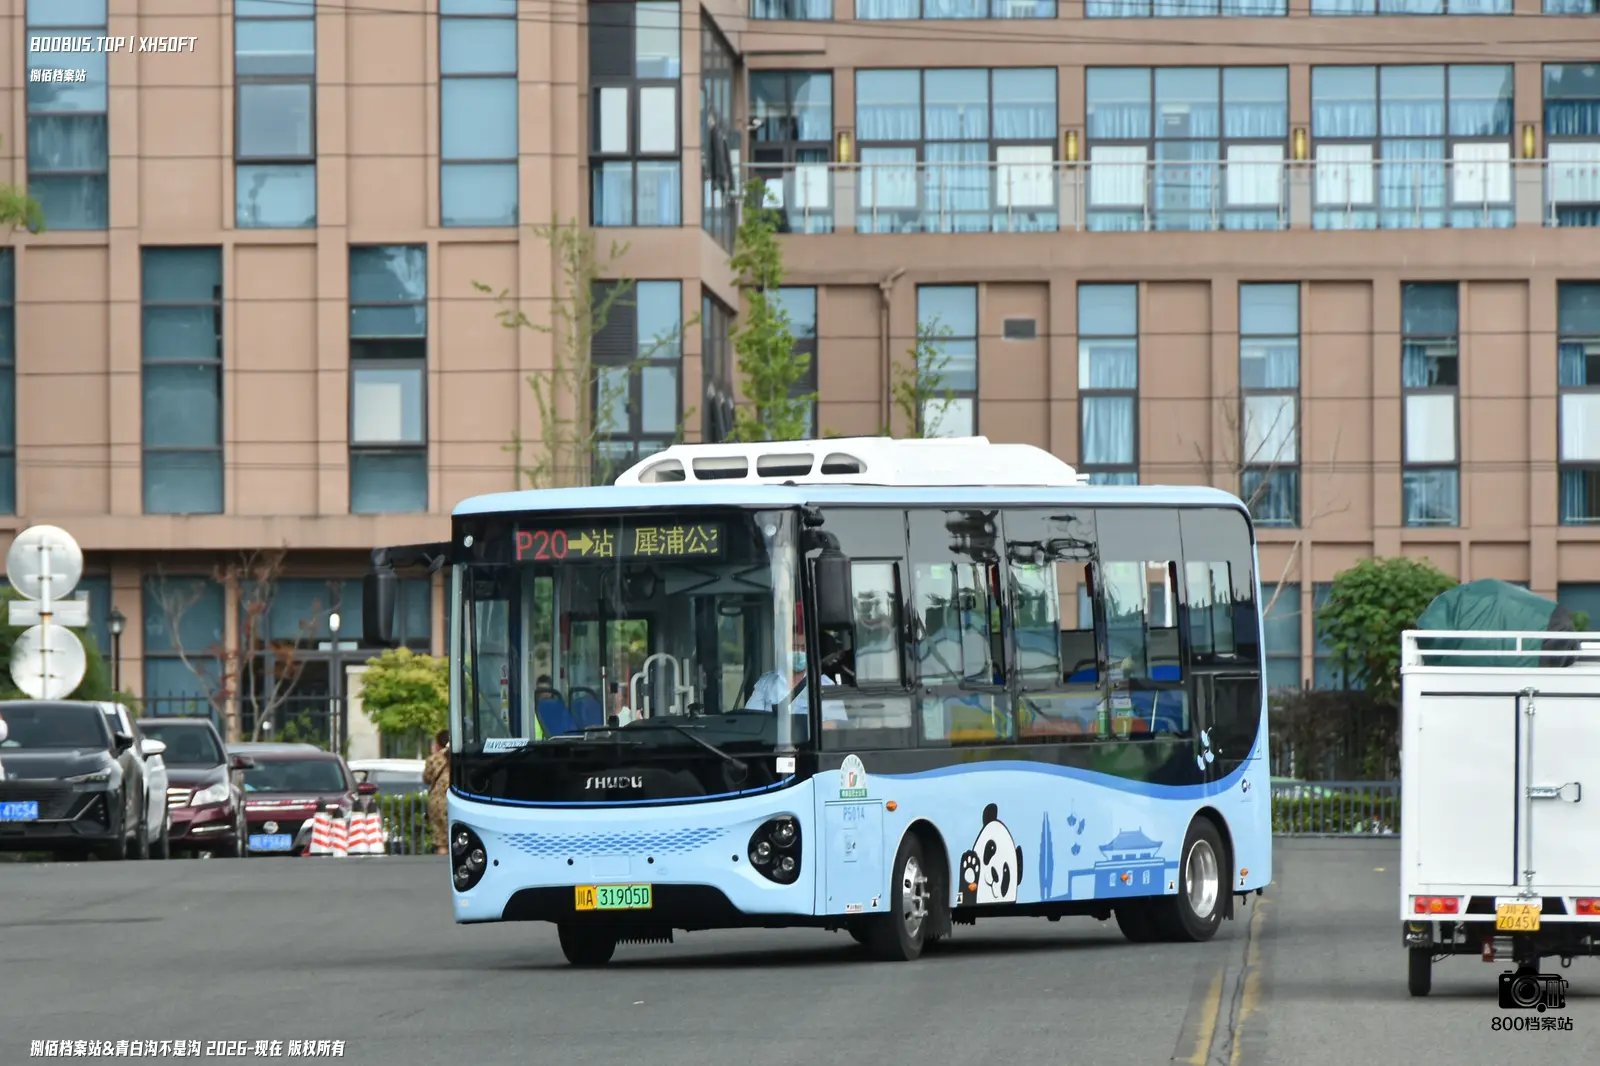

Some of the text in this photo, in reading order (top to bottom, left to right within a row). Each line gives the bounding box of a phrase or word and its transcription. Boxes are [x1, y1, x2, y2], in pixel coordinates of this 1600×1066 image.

[515, 530, 568, 561] P20
[592, 529, 614, 558] 站
[585, 776, 643, 790] SHUDU
[577, 888, 649, 906] 川A 31905D
